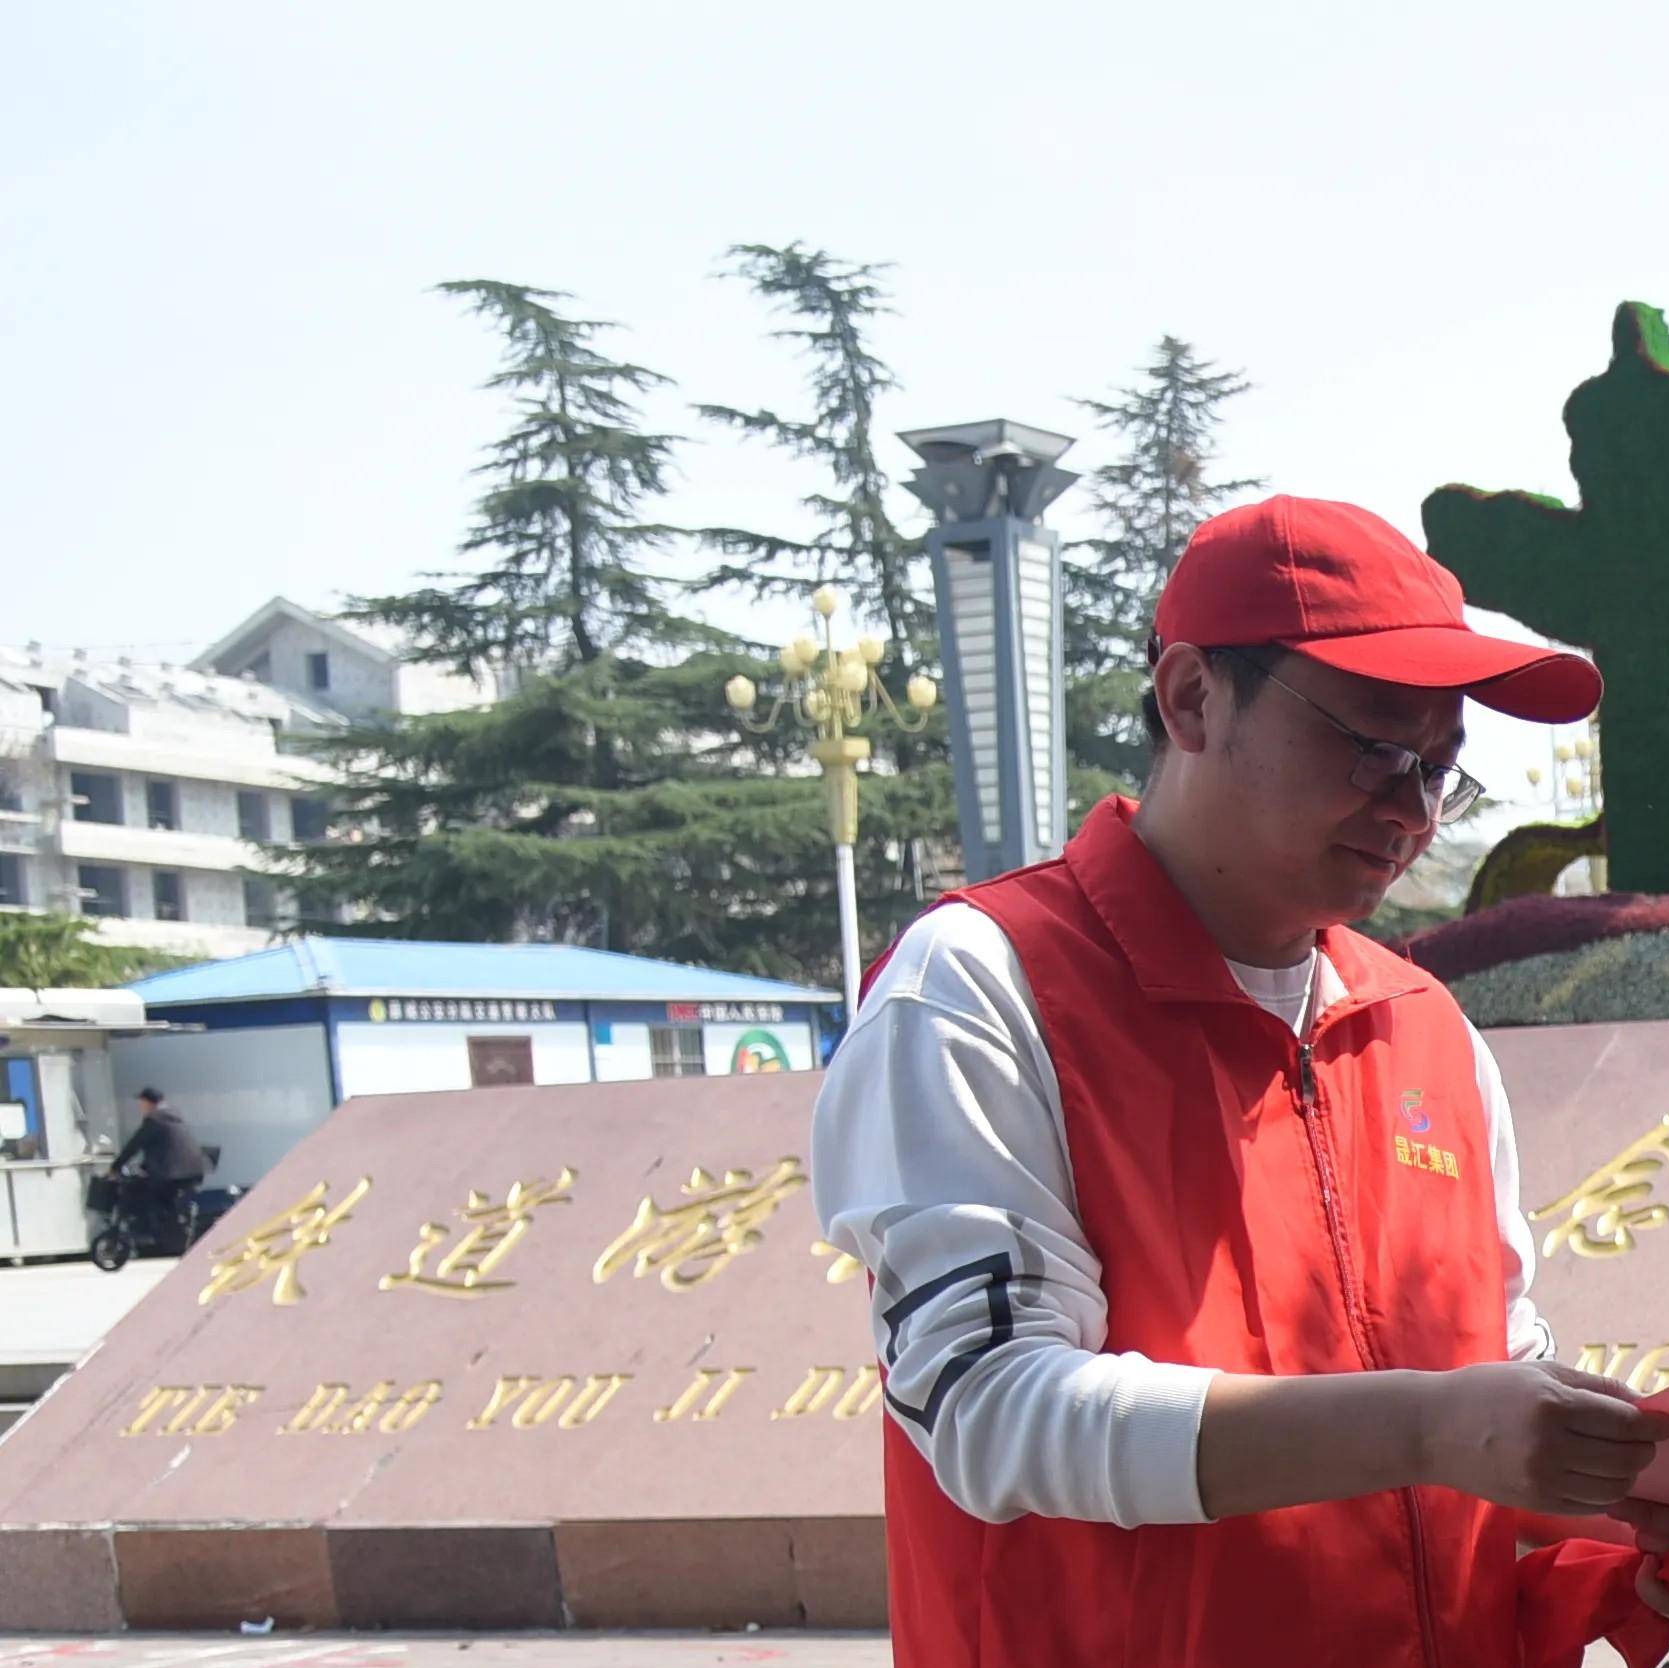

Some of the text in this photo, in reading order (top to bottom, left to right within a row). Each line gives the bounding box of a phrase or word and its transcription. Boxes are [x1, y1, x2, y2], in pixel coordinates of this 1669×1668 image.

[1394, 1135, 1460, 1180] 晟汇集团
[119, 1383, 266, 1436] TIE
[276, 1379, 443, 1435] DAO
[466, 1374, 635, 1429] YOU
[653, 1367, 756, 1422] JI
[770, 1365, 883, 1421] DU
